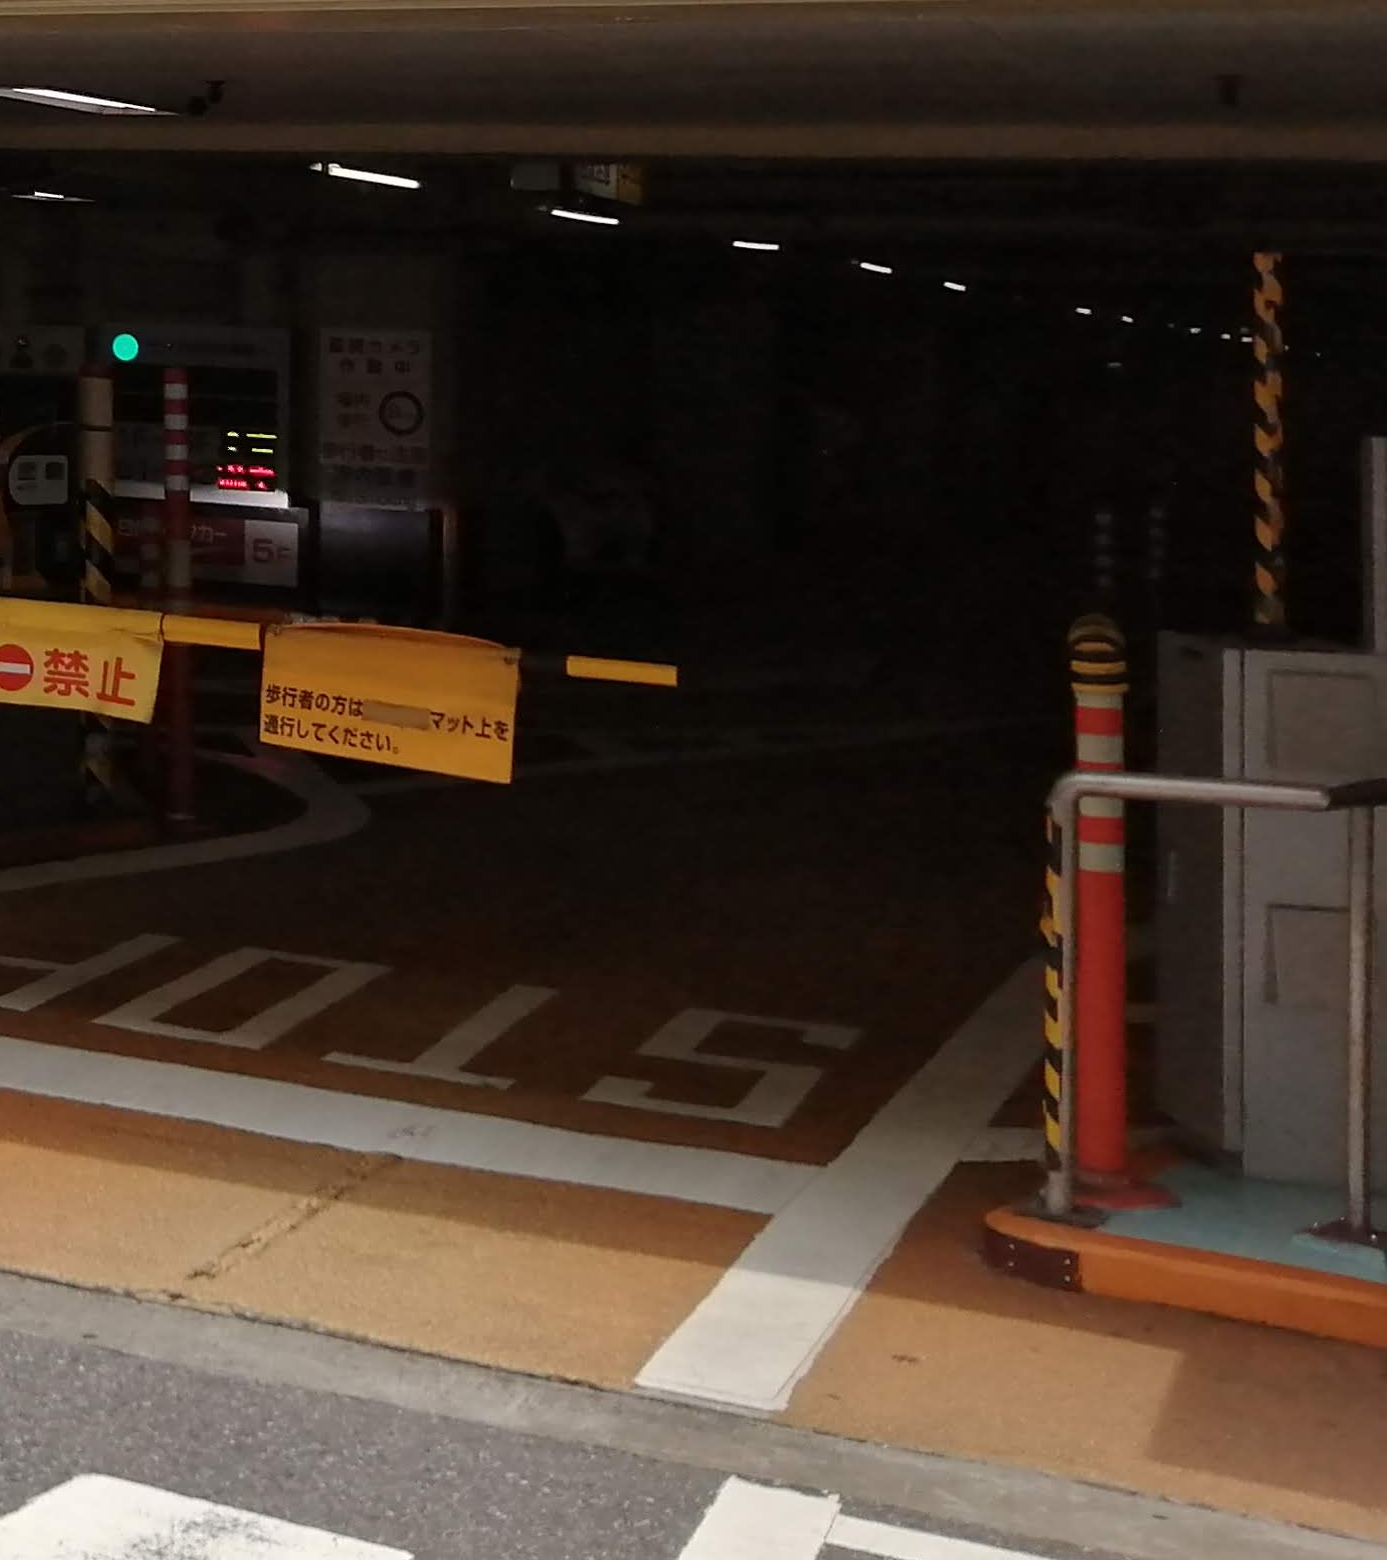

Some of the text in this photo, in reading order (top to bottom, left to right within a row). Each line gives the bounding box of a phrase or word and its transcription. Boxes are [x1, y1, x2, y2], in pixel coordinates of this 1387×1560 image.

[265, 683, 510, 742] 歩行者の方は マット上を
